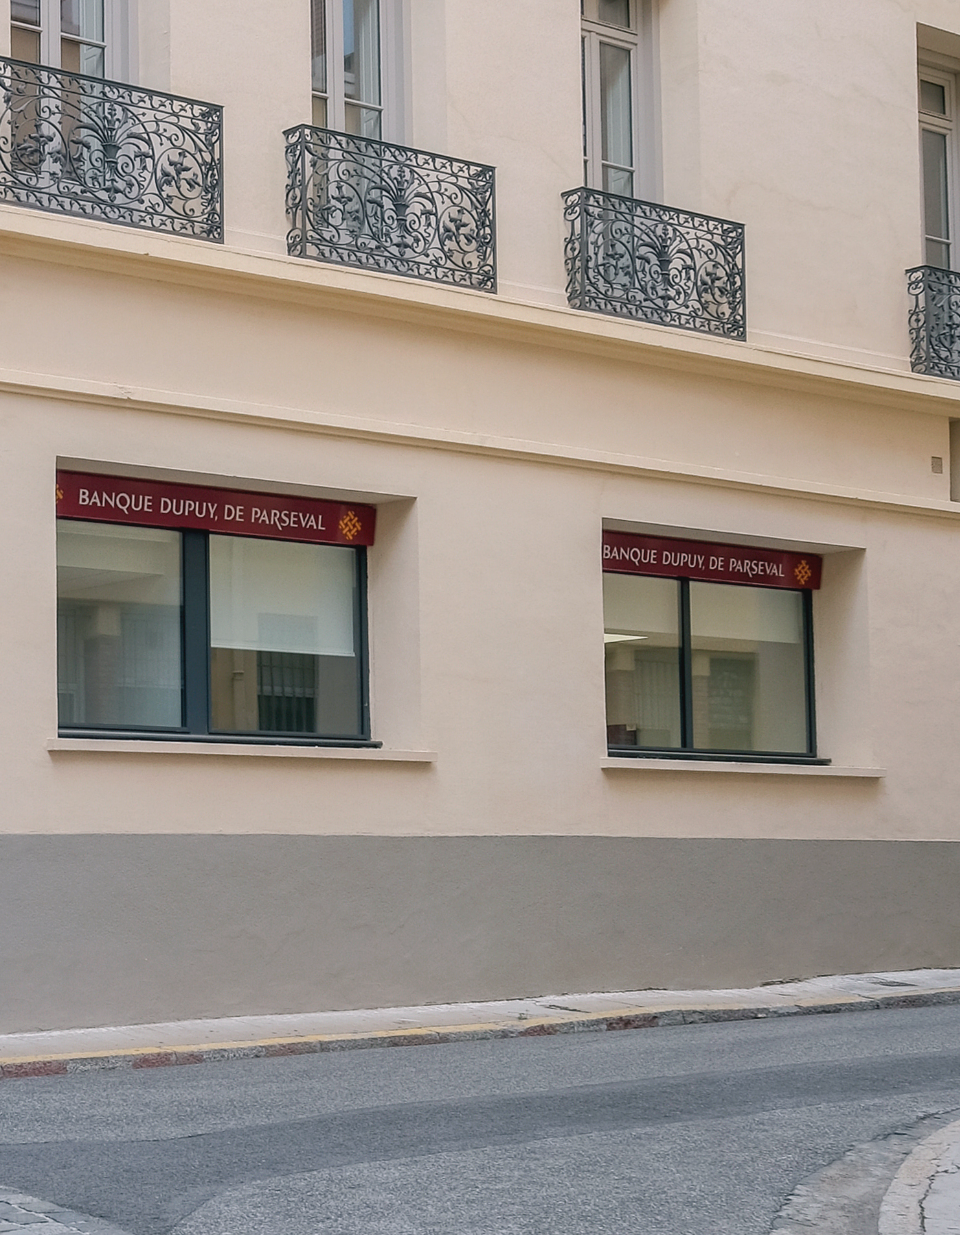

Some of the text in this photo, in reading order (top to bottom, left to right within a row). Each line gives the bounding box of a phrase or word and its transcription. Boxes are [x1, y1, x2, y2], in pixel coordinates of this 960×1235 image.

[78, 487, 326, 531] BANQUE DUPUY, DE PARSEVAL
[602, 544, 786, 578] BANQUE DUPUY, DE PARSEVAL
